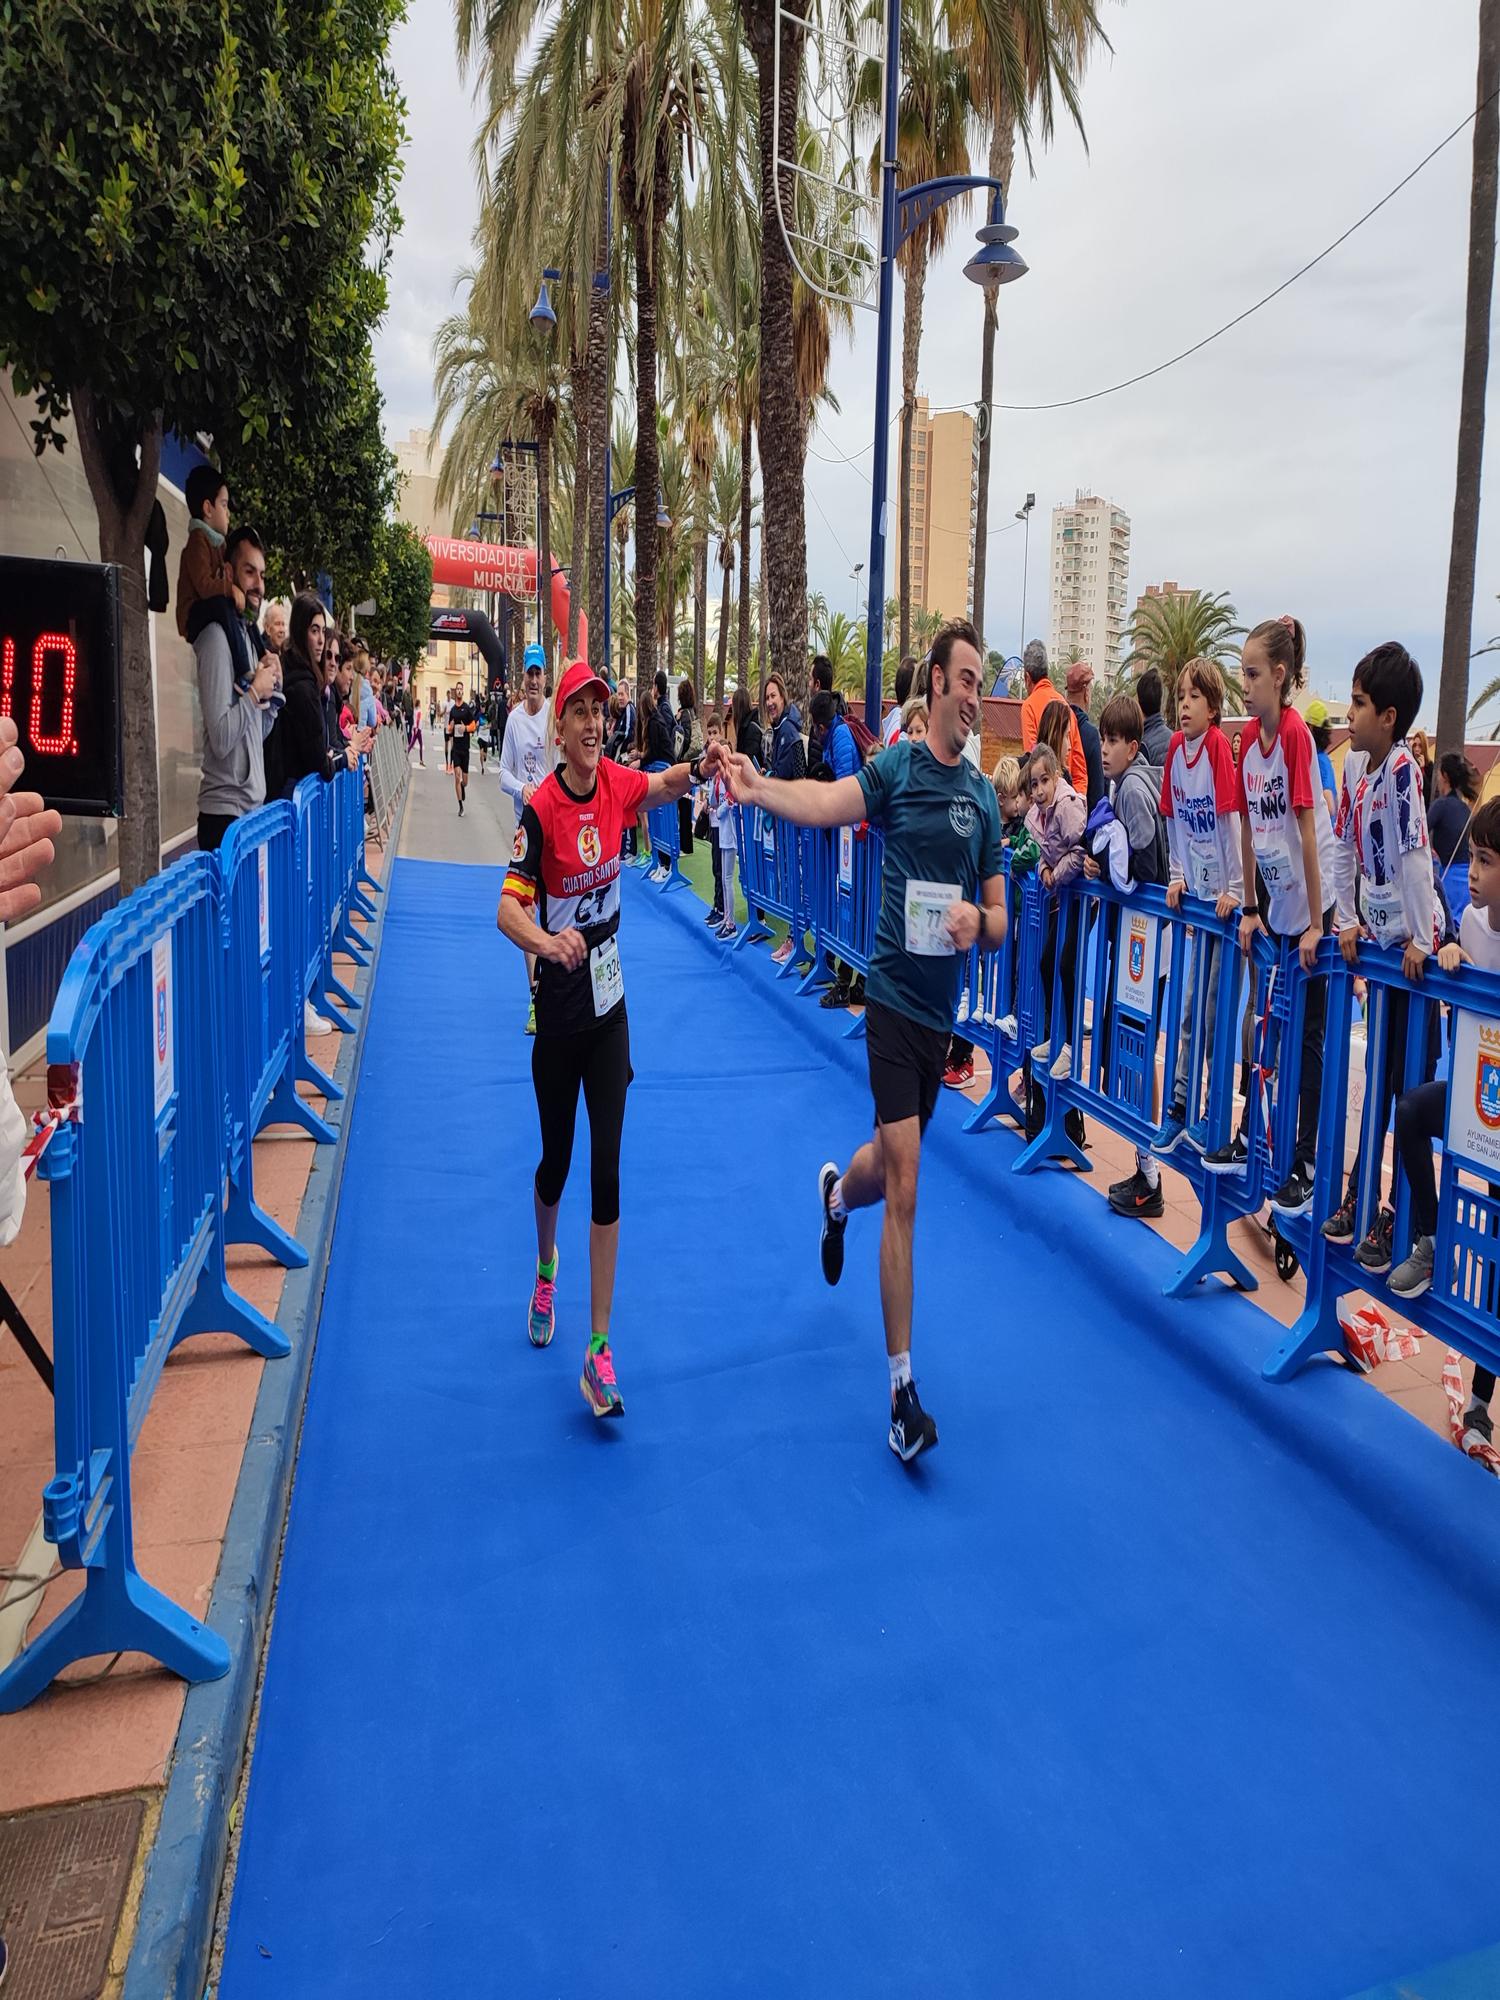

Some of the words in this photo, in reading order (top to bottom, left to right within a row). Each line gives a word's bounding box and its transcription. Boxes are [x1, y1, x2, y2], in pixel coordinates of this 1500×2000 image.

[428, 541, 505, 566] NIVERSIDAD
[509, 551, 526, 568] DE
[473, 570, 524, 591] MURCIA
[562, 870, 594, 893] CUATRO
[926, 909, 941, 929] 77
[1368, 906, 1387, 927] 529
[1467, 1139, 1476, 1151] DE
[1476, 1143, 1489, 1156] SAN
[1489, 1149, 1500, 1160] JAV
